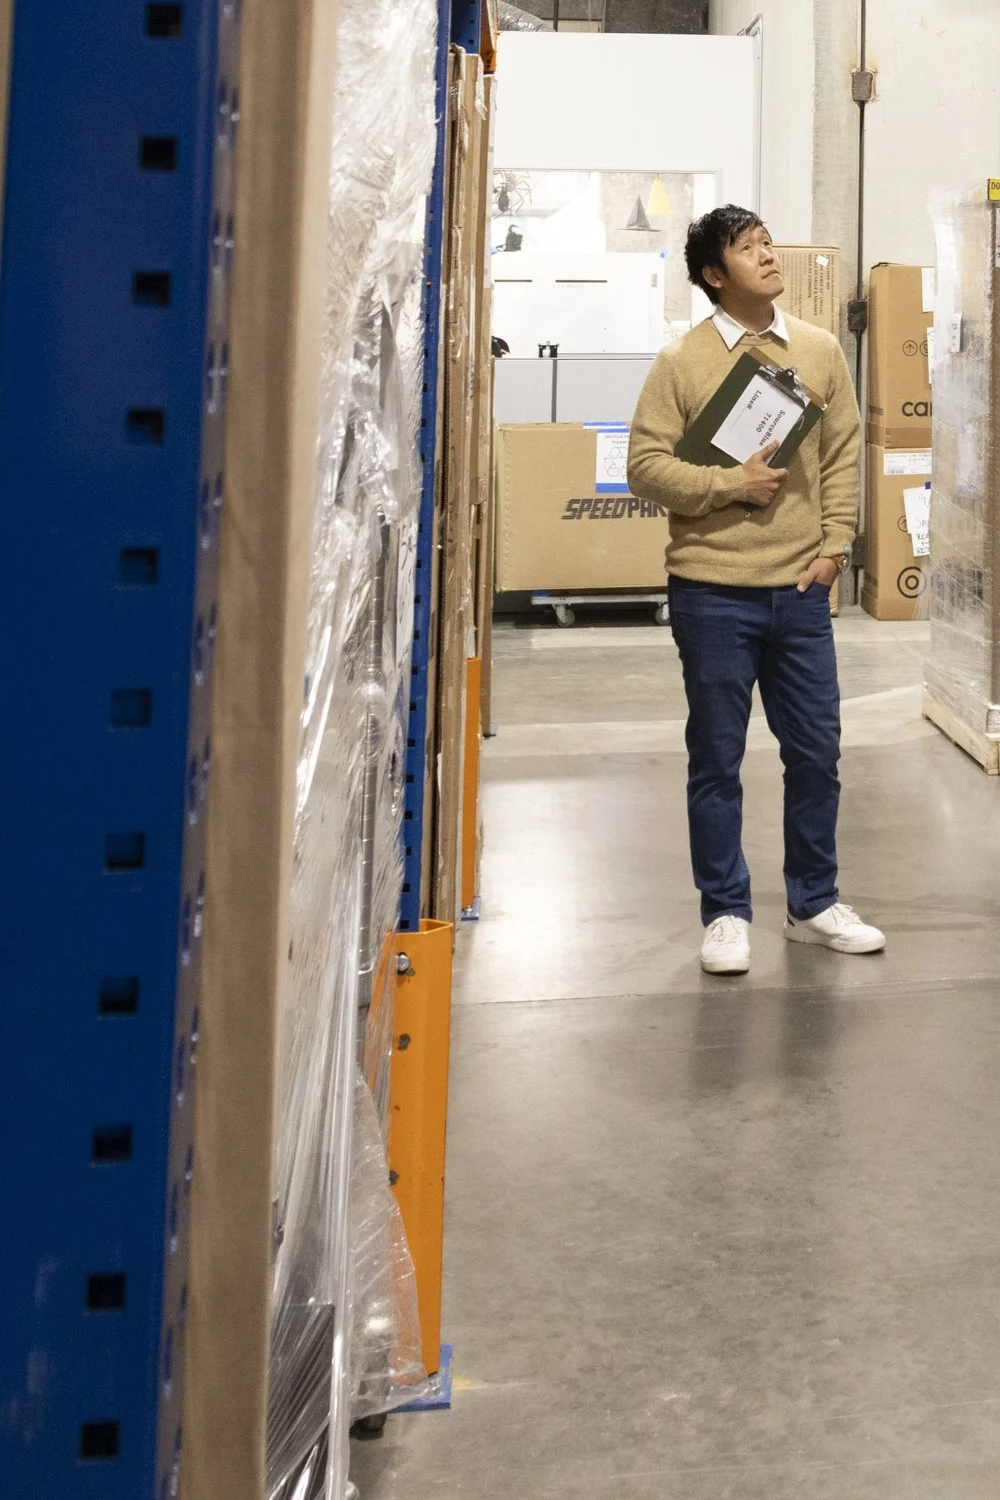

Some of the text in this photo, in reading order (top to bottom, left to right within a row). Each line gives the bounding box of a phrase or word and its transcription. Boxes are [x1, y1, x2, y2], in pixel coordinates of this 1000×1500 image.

[991, 182, 1000, 190] DO
[747, 389, 762, 411] Line#
[756, 412, 772, 433] 71400
[759, 409, 786, 447] SourceBlue
